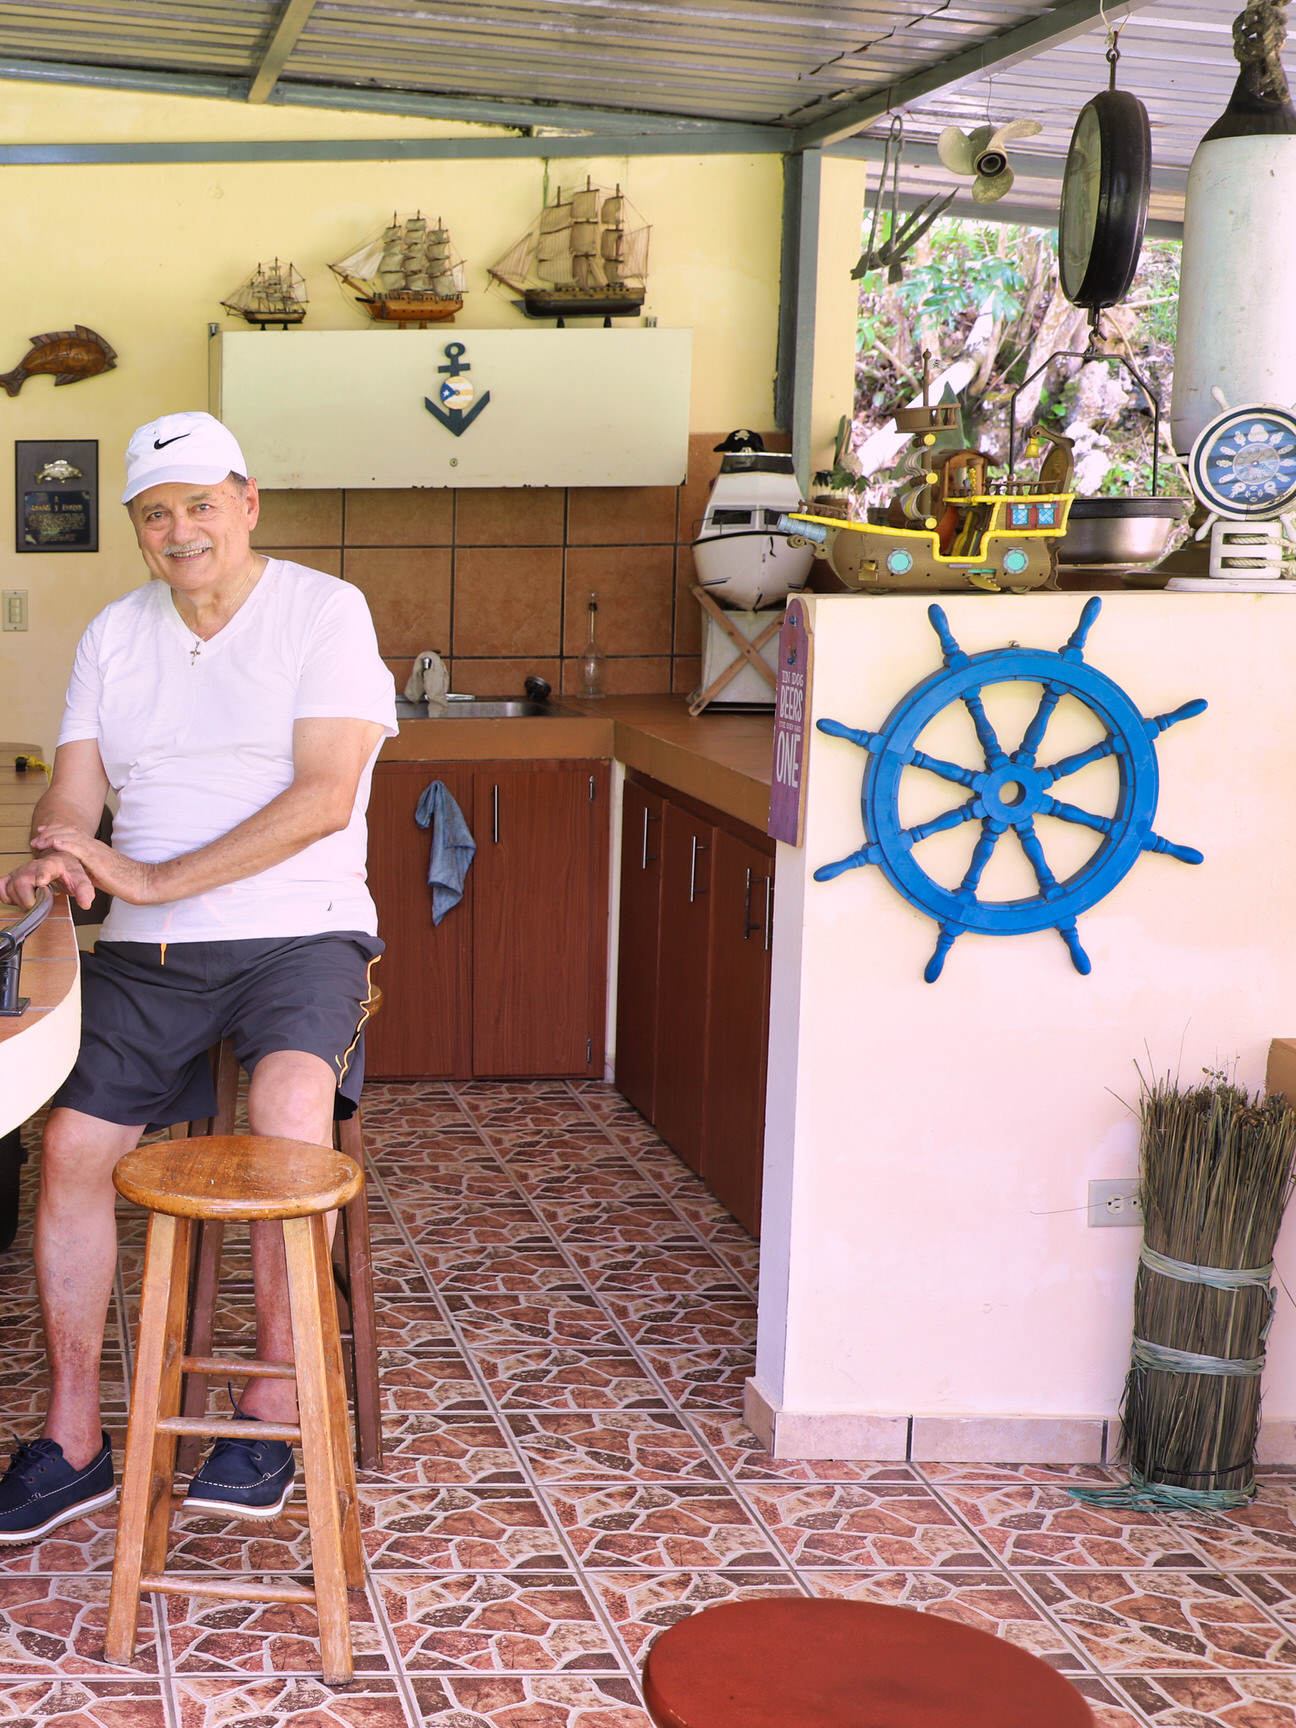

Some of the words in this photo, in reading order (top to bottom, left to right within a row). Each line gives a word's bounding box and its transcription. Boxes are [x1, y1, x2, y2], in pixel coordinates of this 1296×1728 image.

[782, 670, 791, 683] IN
[791, 672, 804, 687] DOG
[780, 684, 804, 722] BEERS
[776, 731, 801, 788] ONE
